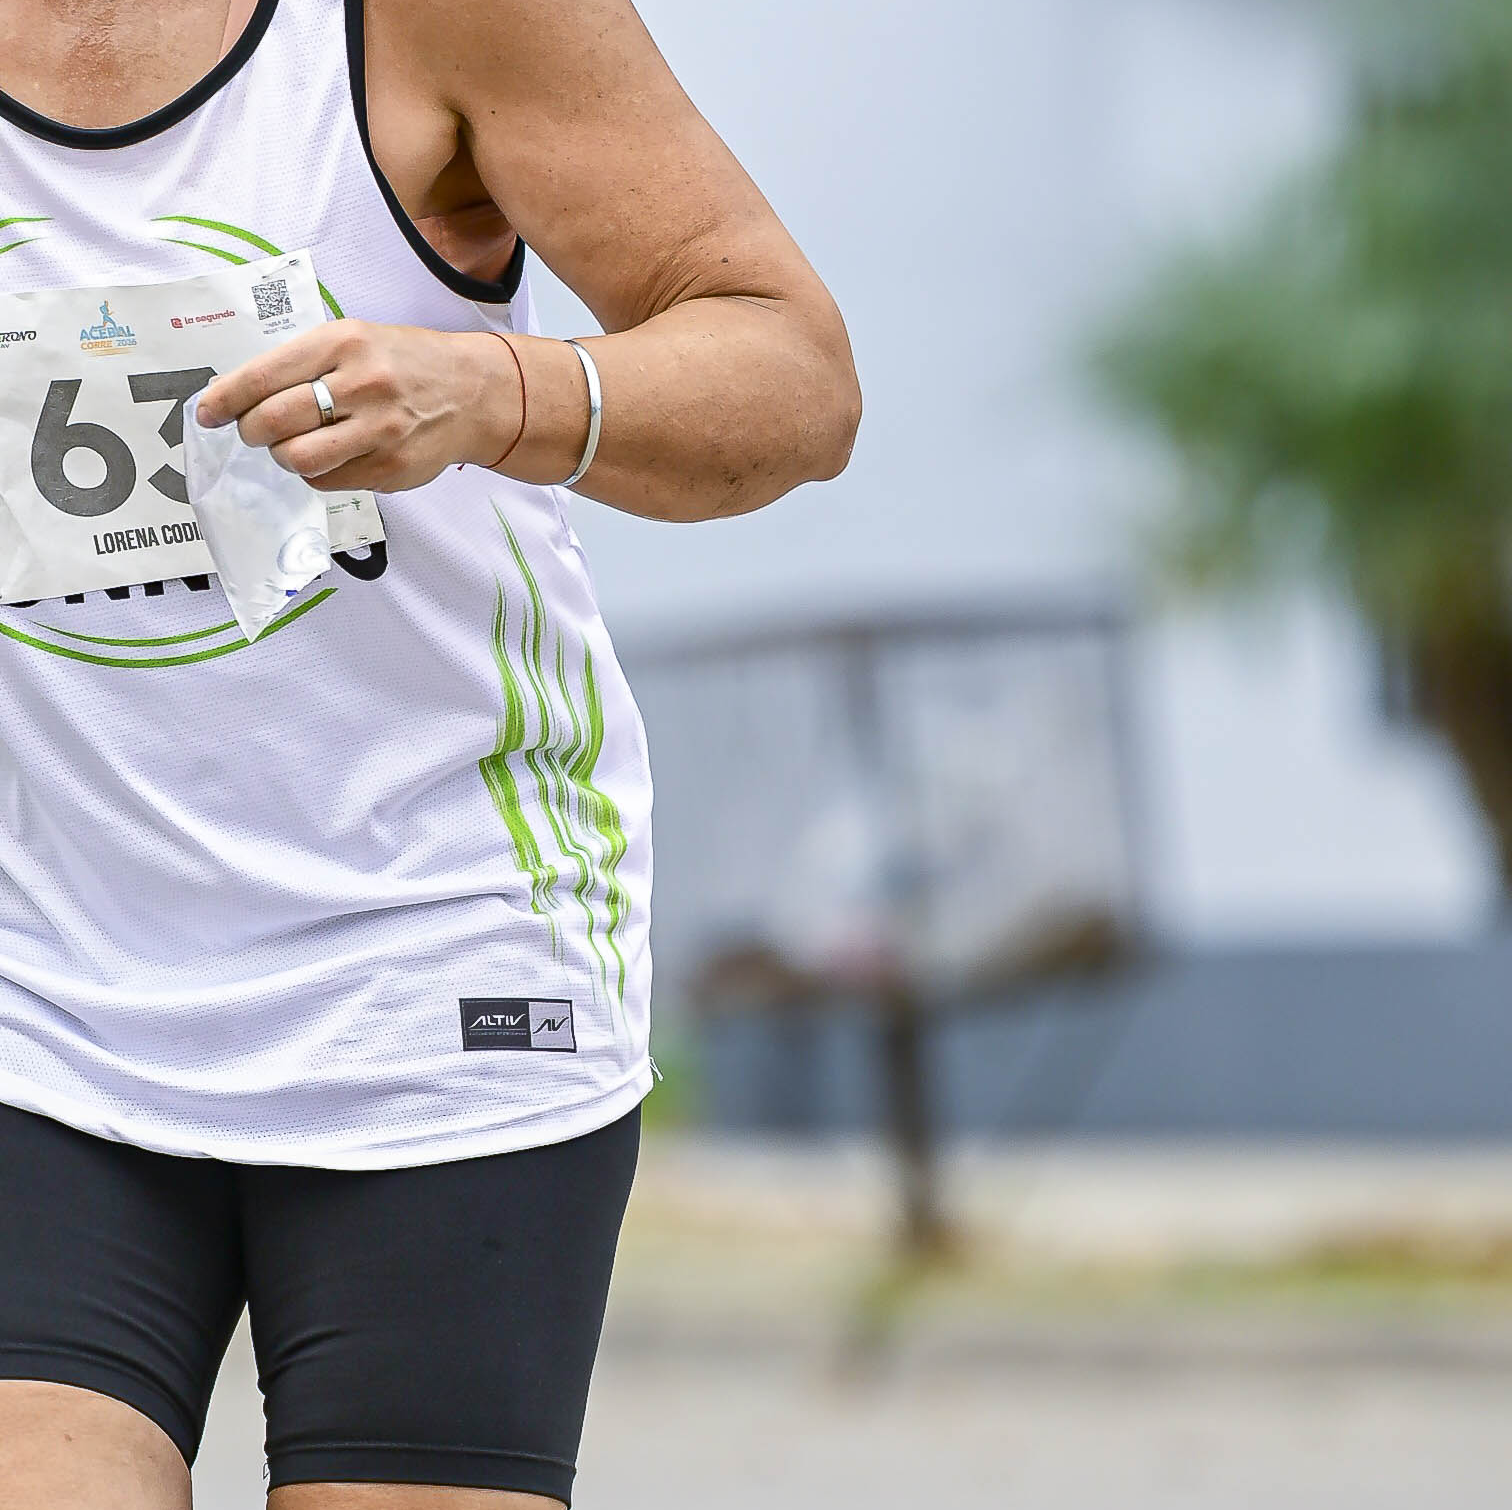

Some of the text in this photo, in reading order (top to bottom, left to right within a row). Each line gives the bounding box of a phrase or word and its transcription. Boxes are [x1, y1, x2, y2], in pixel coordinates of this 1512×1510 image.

[195, 309, 236, 323] segunda
[80, 325, 136, 341] ACEBAL
[80, 340, 113, 350] CORRE
[31, 367, 218, 517] 63
[93, 521, 205, 555] LORENA CODI
[468, 1014, 526, 1028] ALTIV
